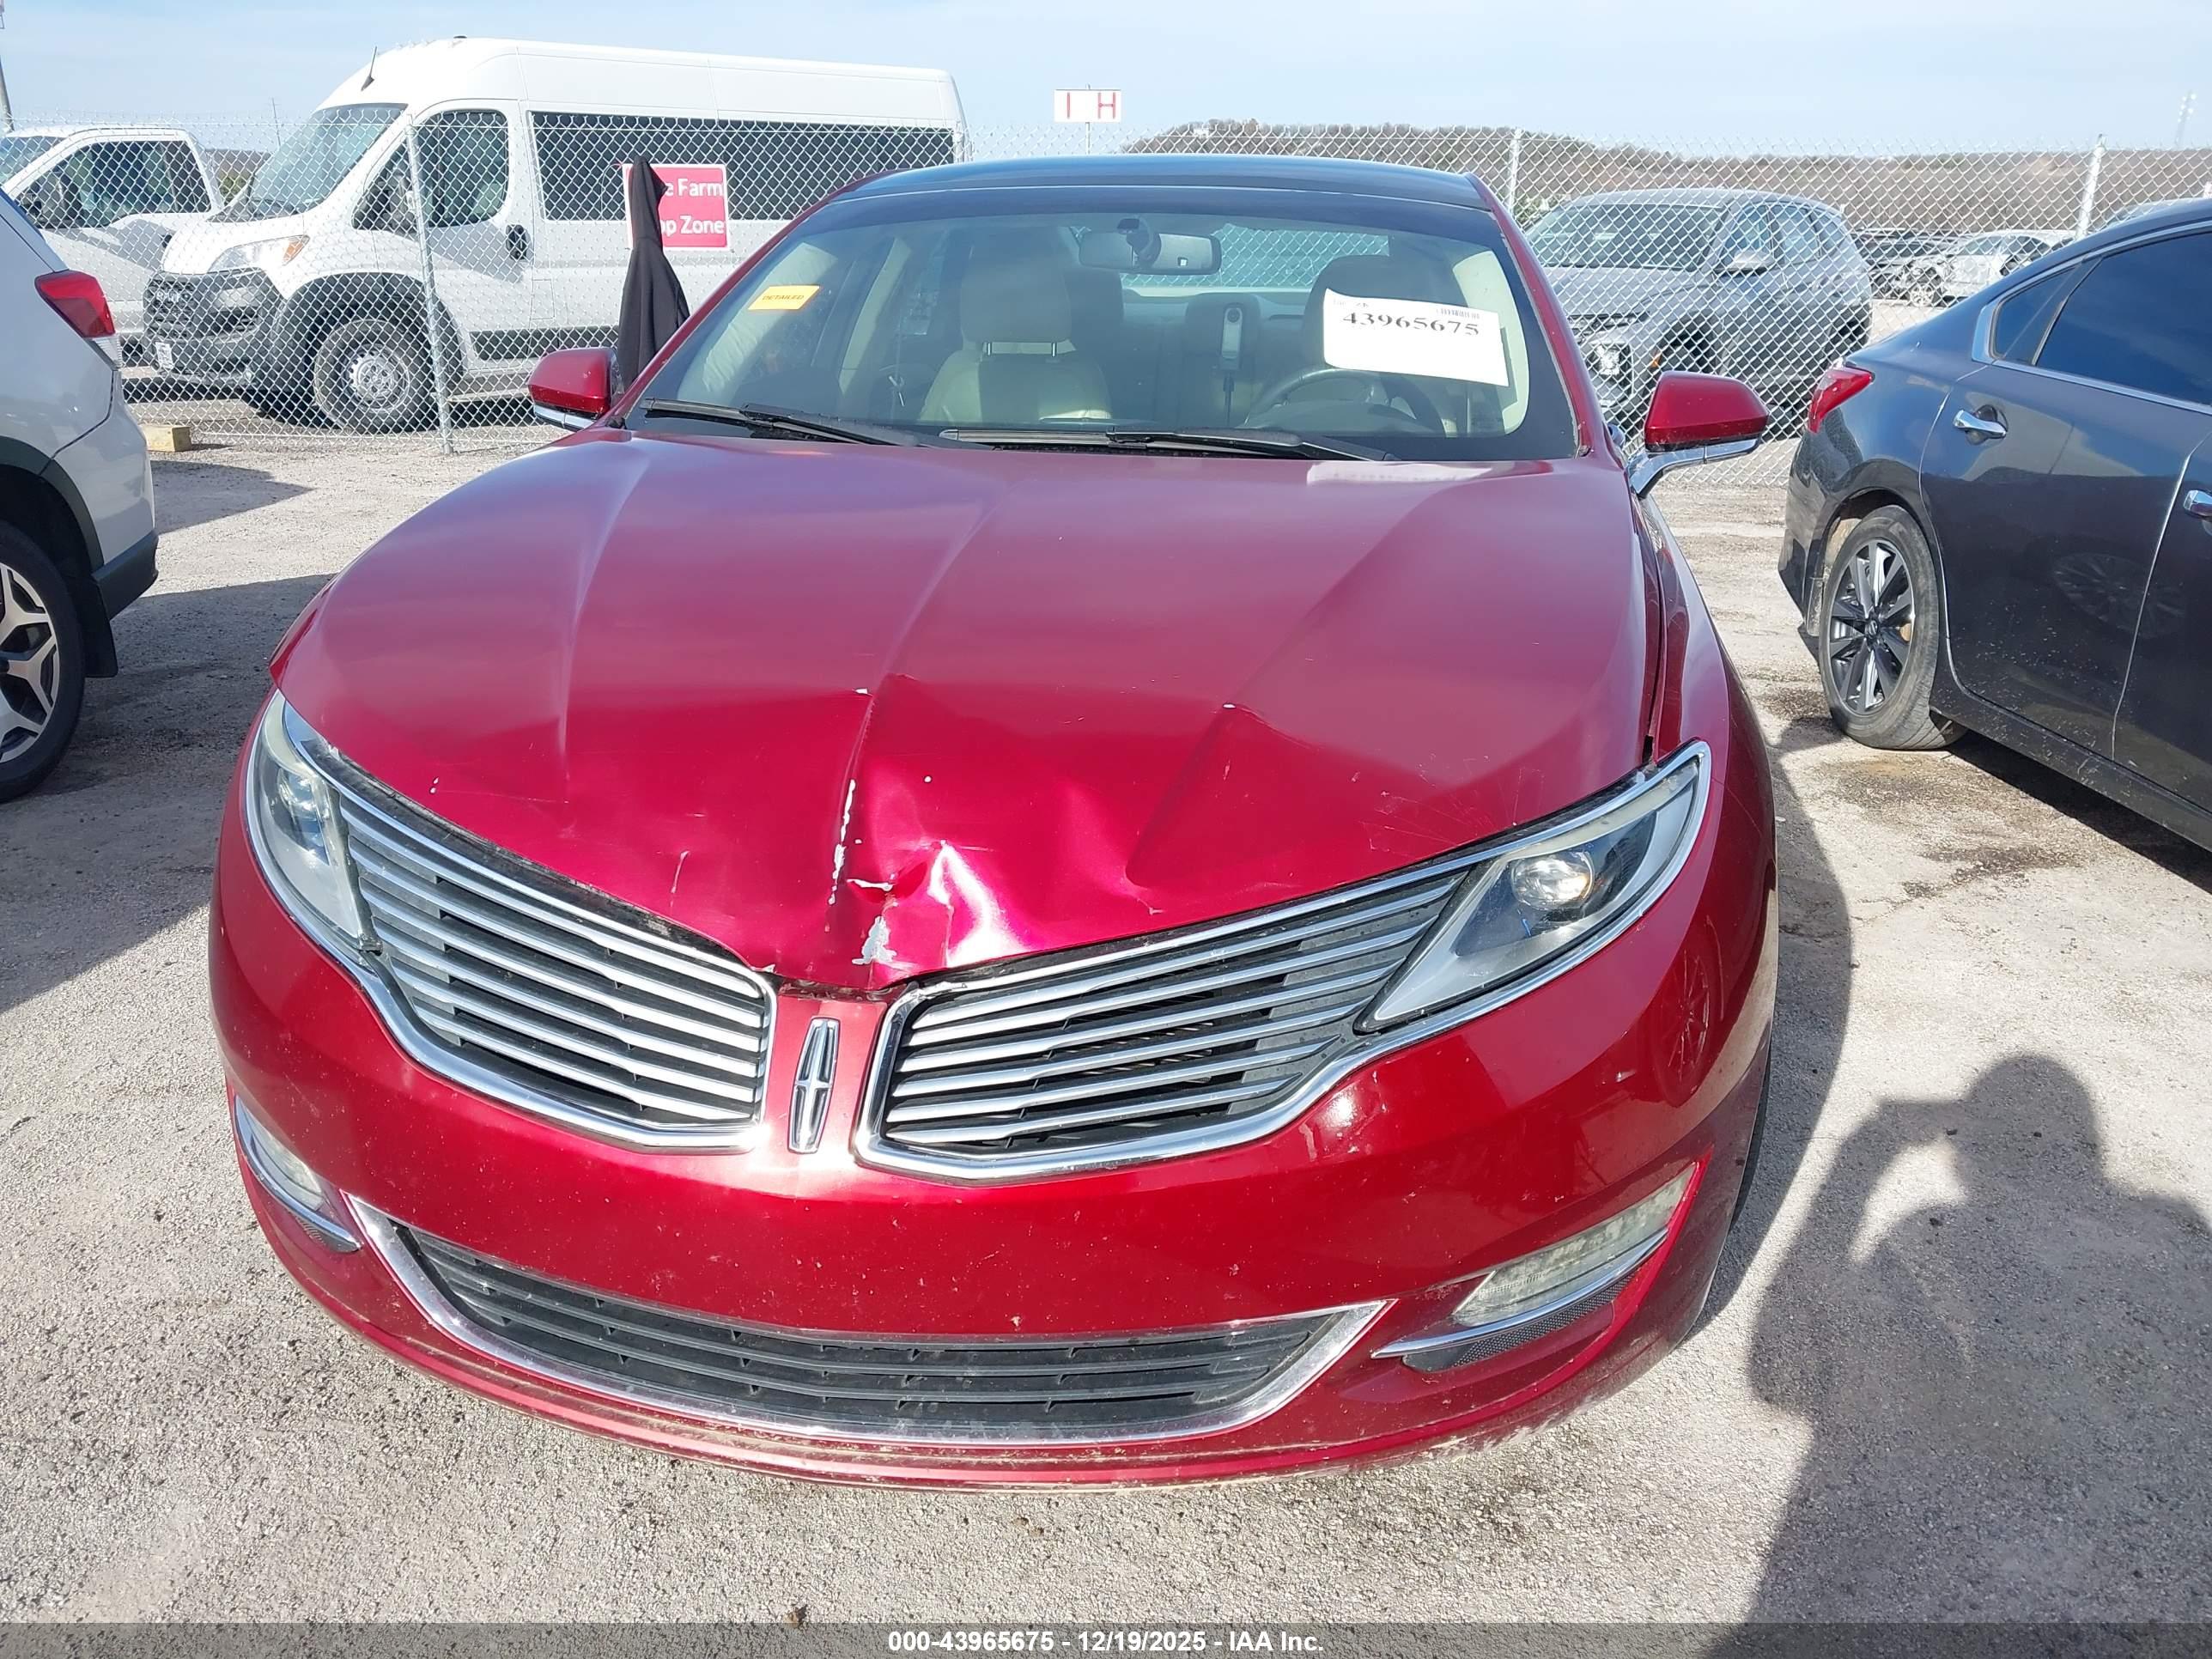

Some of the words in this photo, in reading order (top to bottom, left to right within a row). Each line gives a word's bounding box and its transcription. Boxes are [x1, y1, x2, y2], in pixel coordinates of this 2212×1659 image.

[1097, 91, 1115, 119] H
[678, 178, 723, 197] Farm
[679, 215, 725, 234] Zone
[1342, 312, 1479, 335] 43965675
